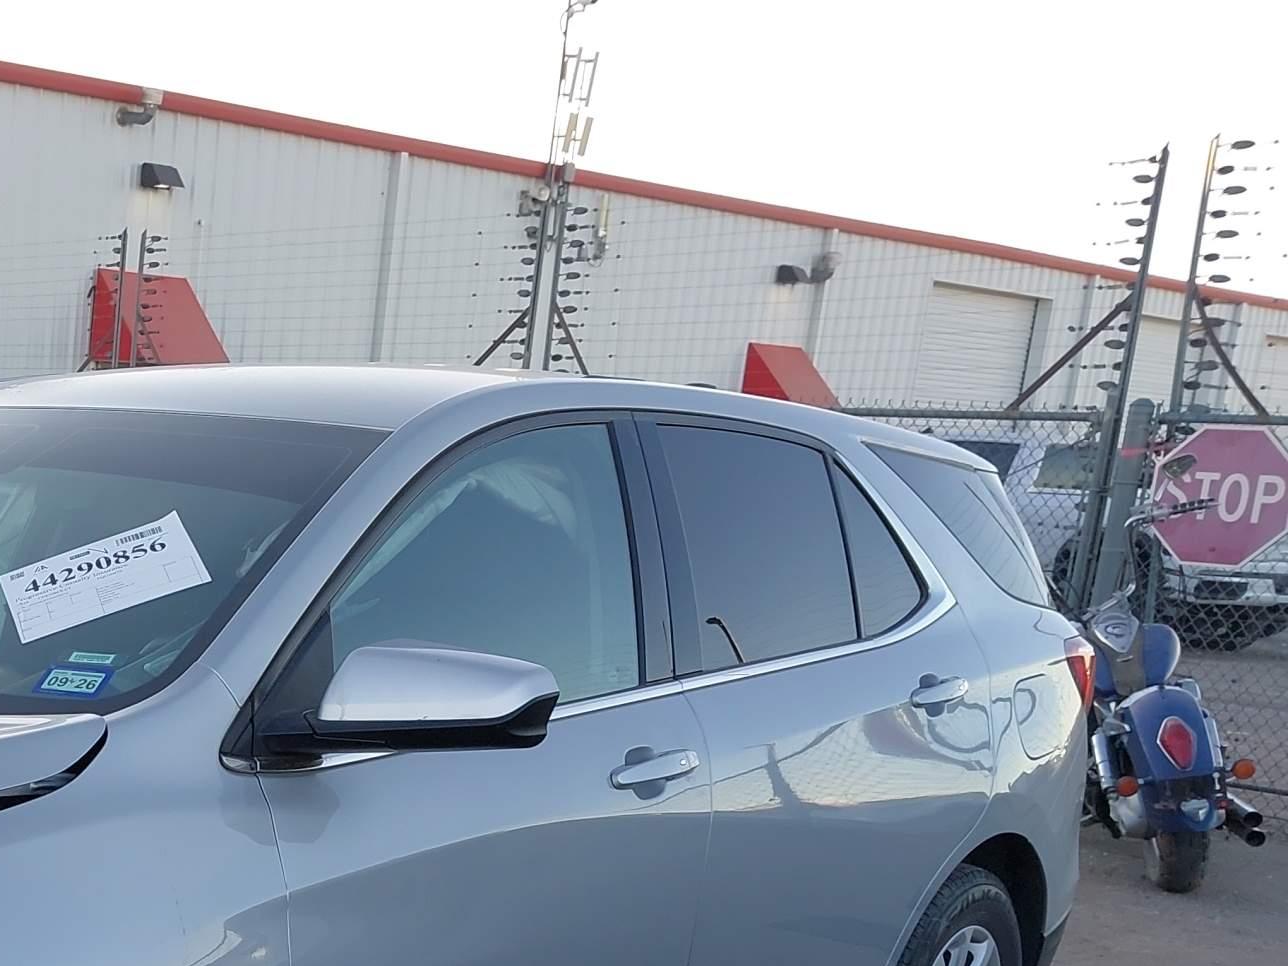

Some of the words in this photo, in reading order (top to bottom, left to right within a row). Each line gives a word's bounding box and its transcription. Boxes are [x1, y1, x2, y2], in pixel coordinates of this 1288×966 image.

[1160, 469, 1287, 524] STOP
[24, 537, 167, 593] 44290856
[46, 676, 69, 687] 09
[74, 678, 99, 690] 26
